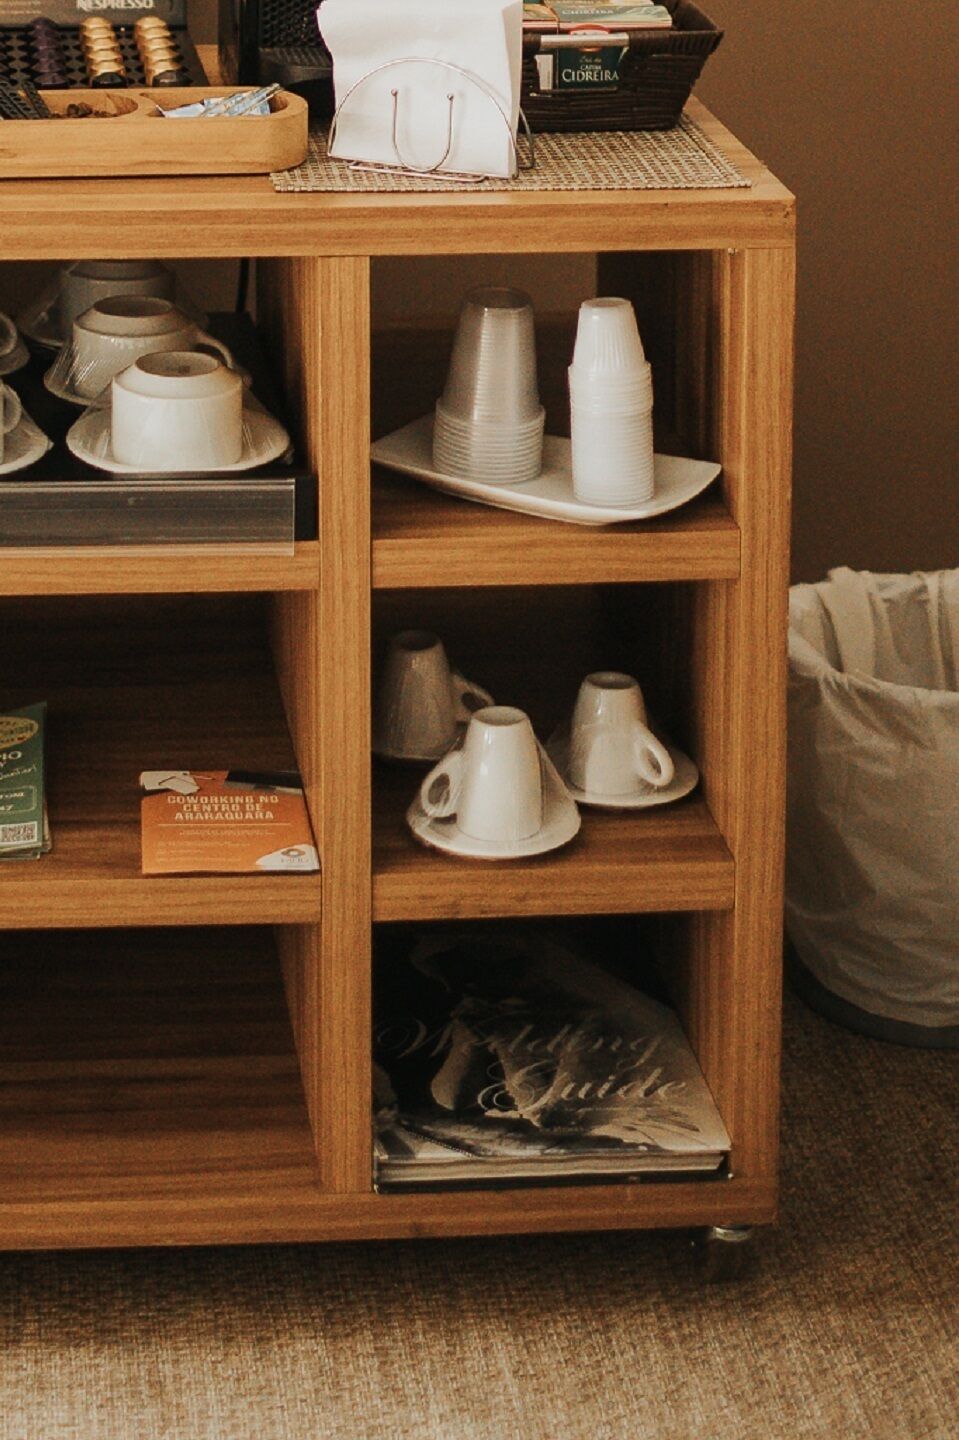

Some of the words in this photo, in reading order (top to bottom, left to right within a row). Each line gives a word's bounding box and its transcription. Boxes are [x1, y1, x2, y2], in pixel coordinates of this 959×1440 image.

[561, 68, 620, 83] CIDREIRA
[167, 795, 254, 804] COWORKING
[259, 794, 279, 803] NO
[183, 803, 240, 812] CENTRO
[245, 803, 263, 811] DE
[174, 811, 275, 820] ARARAQUARA
[477, 1057, 688, 1117] Guide
